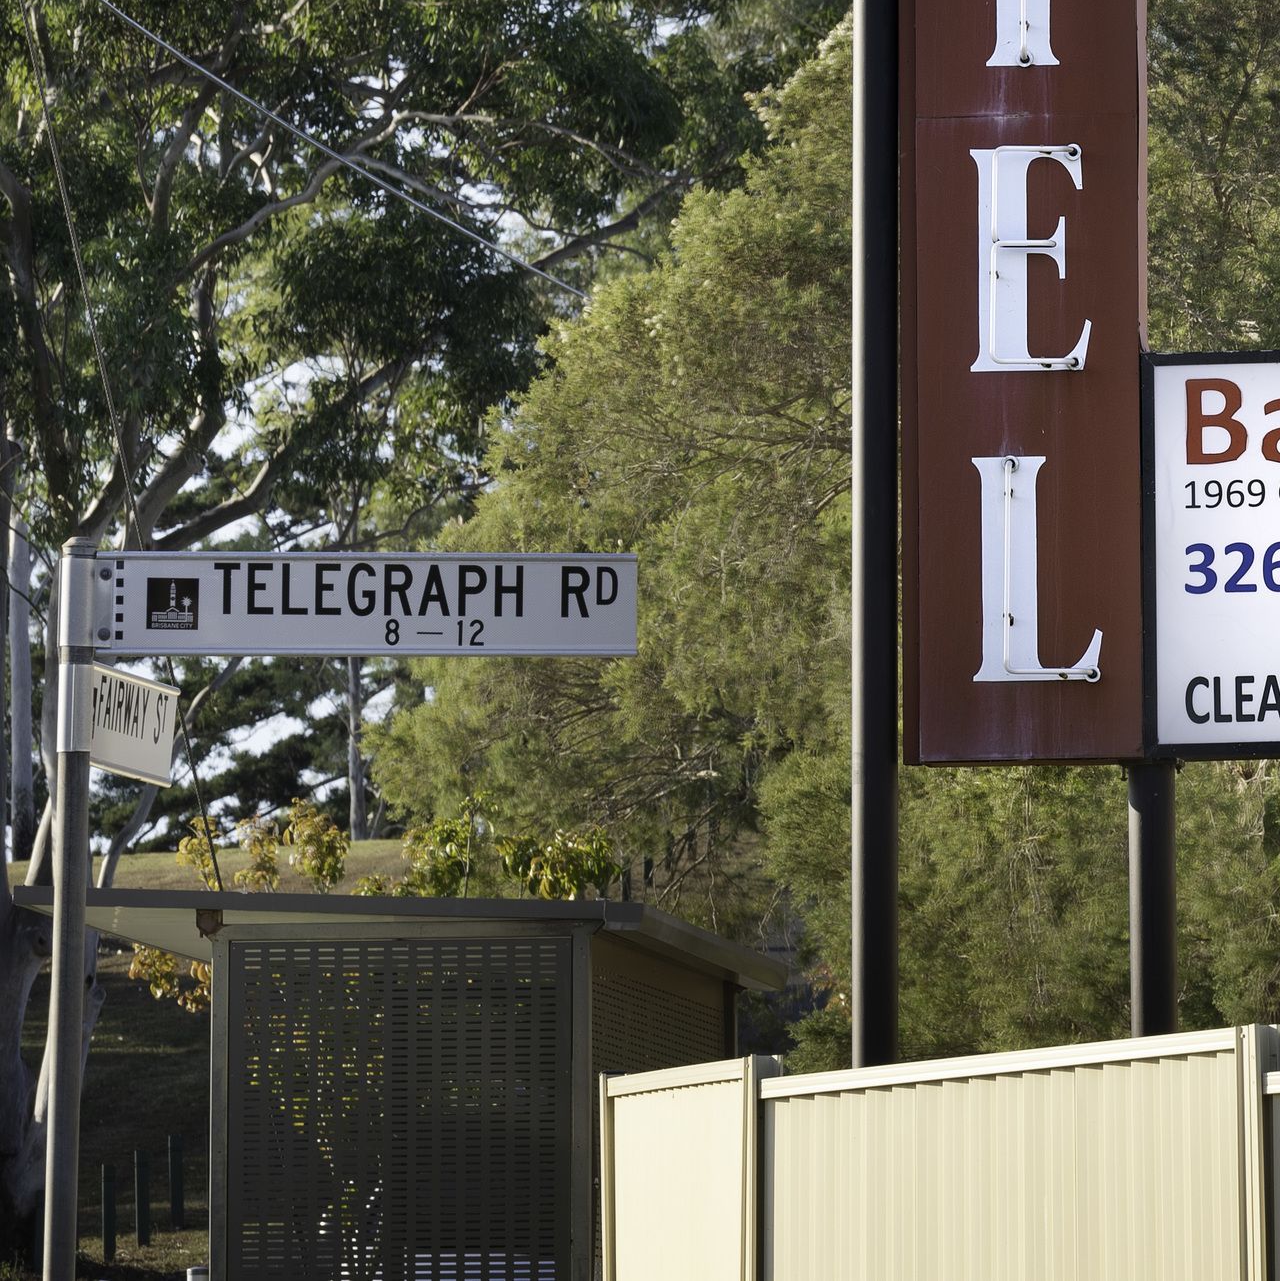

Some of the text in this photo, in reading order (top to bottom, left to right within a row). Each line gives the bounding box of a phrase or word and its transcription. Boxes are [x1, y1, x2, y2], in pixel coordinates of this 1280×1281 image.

[1184, 479, 1266, 510] 1969
[214, 562, 619, 618] TELEGRAPH RD
[97, 675, 169, 744] FAIRWAY ST
